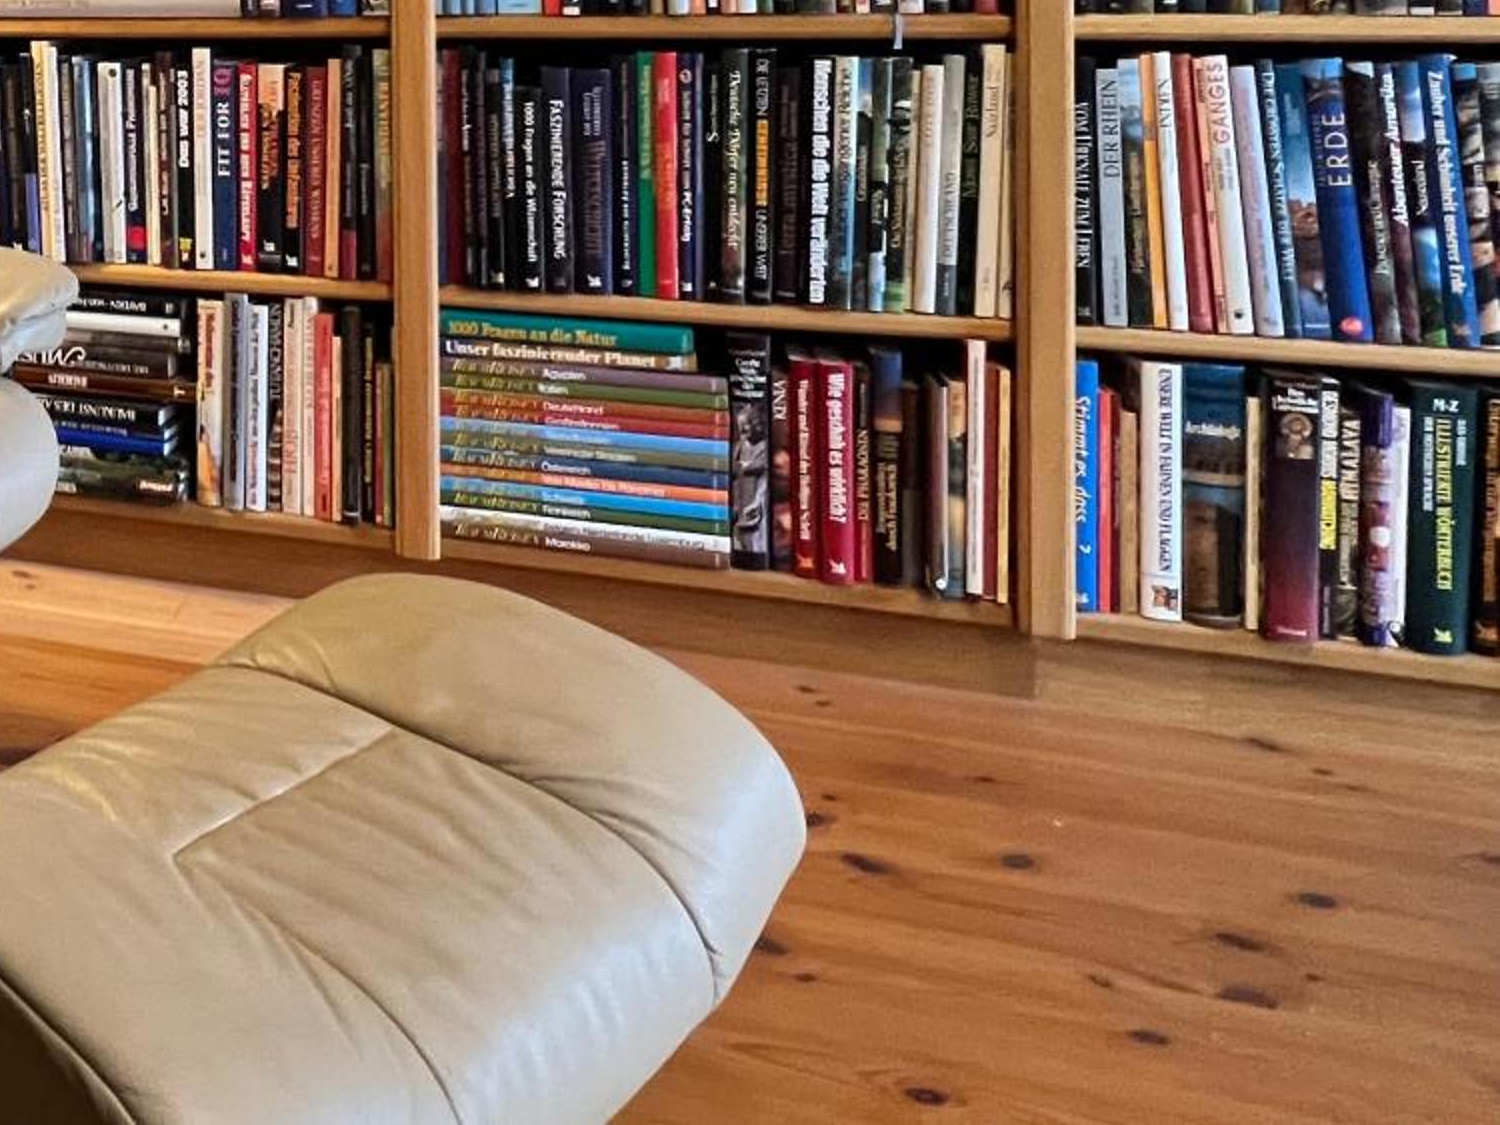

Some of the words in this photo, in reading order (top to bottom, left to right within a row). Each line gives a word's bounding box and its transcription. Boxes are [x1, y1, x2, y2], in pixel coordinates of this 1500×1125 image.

[755, 58, 769, 74] DIE
[177, 70, 189, 107] 2003
[755, 76, 769, 116] LETZTEN
[813, 59, 831, 132] Menschen
[1100, 77, 1119, 136] RHEIN
[1208, 62, 1231, 144] GANGES
[1378, 74, 1400, 143] Amerika
[1427, 70, 1446, 117] Zauber
[217, 102, 230, 140] FOR
[1432, 119, 1449, 146] und
[217, 147, 231, 175] FIT
[549, 100, 565, 188] FASZINIERENDE
[812, 134, 830, 157] die
[1102, 138, 1120, 178] DER
[1321, 111, 1350, 188] ERDE
[812, 159, 829, 182] die
[1387, 145, 1409, 226] Abenteuer
[1435, 147, 1457, 212] Schönheit
[811, 183, 829, 216] Welt
[552, 190, 567, 261] FORSCHUNG
[1445, 213, 1460, 262] unserer
[755, 254, 769, 280] WELT
[810, 217, 828, 304] veränderten
[1449, 264, 1467, 295] Erde
[444, 340, 490, 357] Unser
[552, 327, 572, 343] die
[771, 379, 787, 421] KENIA
[828, 372, 845, 398] Wie
[1158, 368, 1173, 409] UNSERE
[825, 399, 845, 450] geschah
[1075, 395, 1091, 457] Stimmt
[1158, 411, 1173, 440] WELT
[829, 450, 843, 466] es
[1158, 441, 1173, 454] IN
[1340, 419, 1361, 501] HIMALAYA
[828, 466, 847, 524] wirklich?
